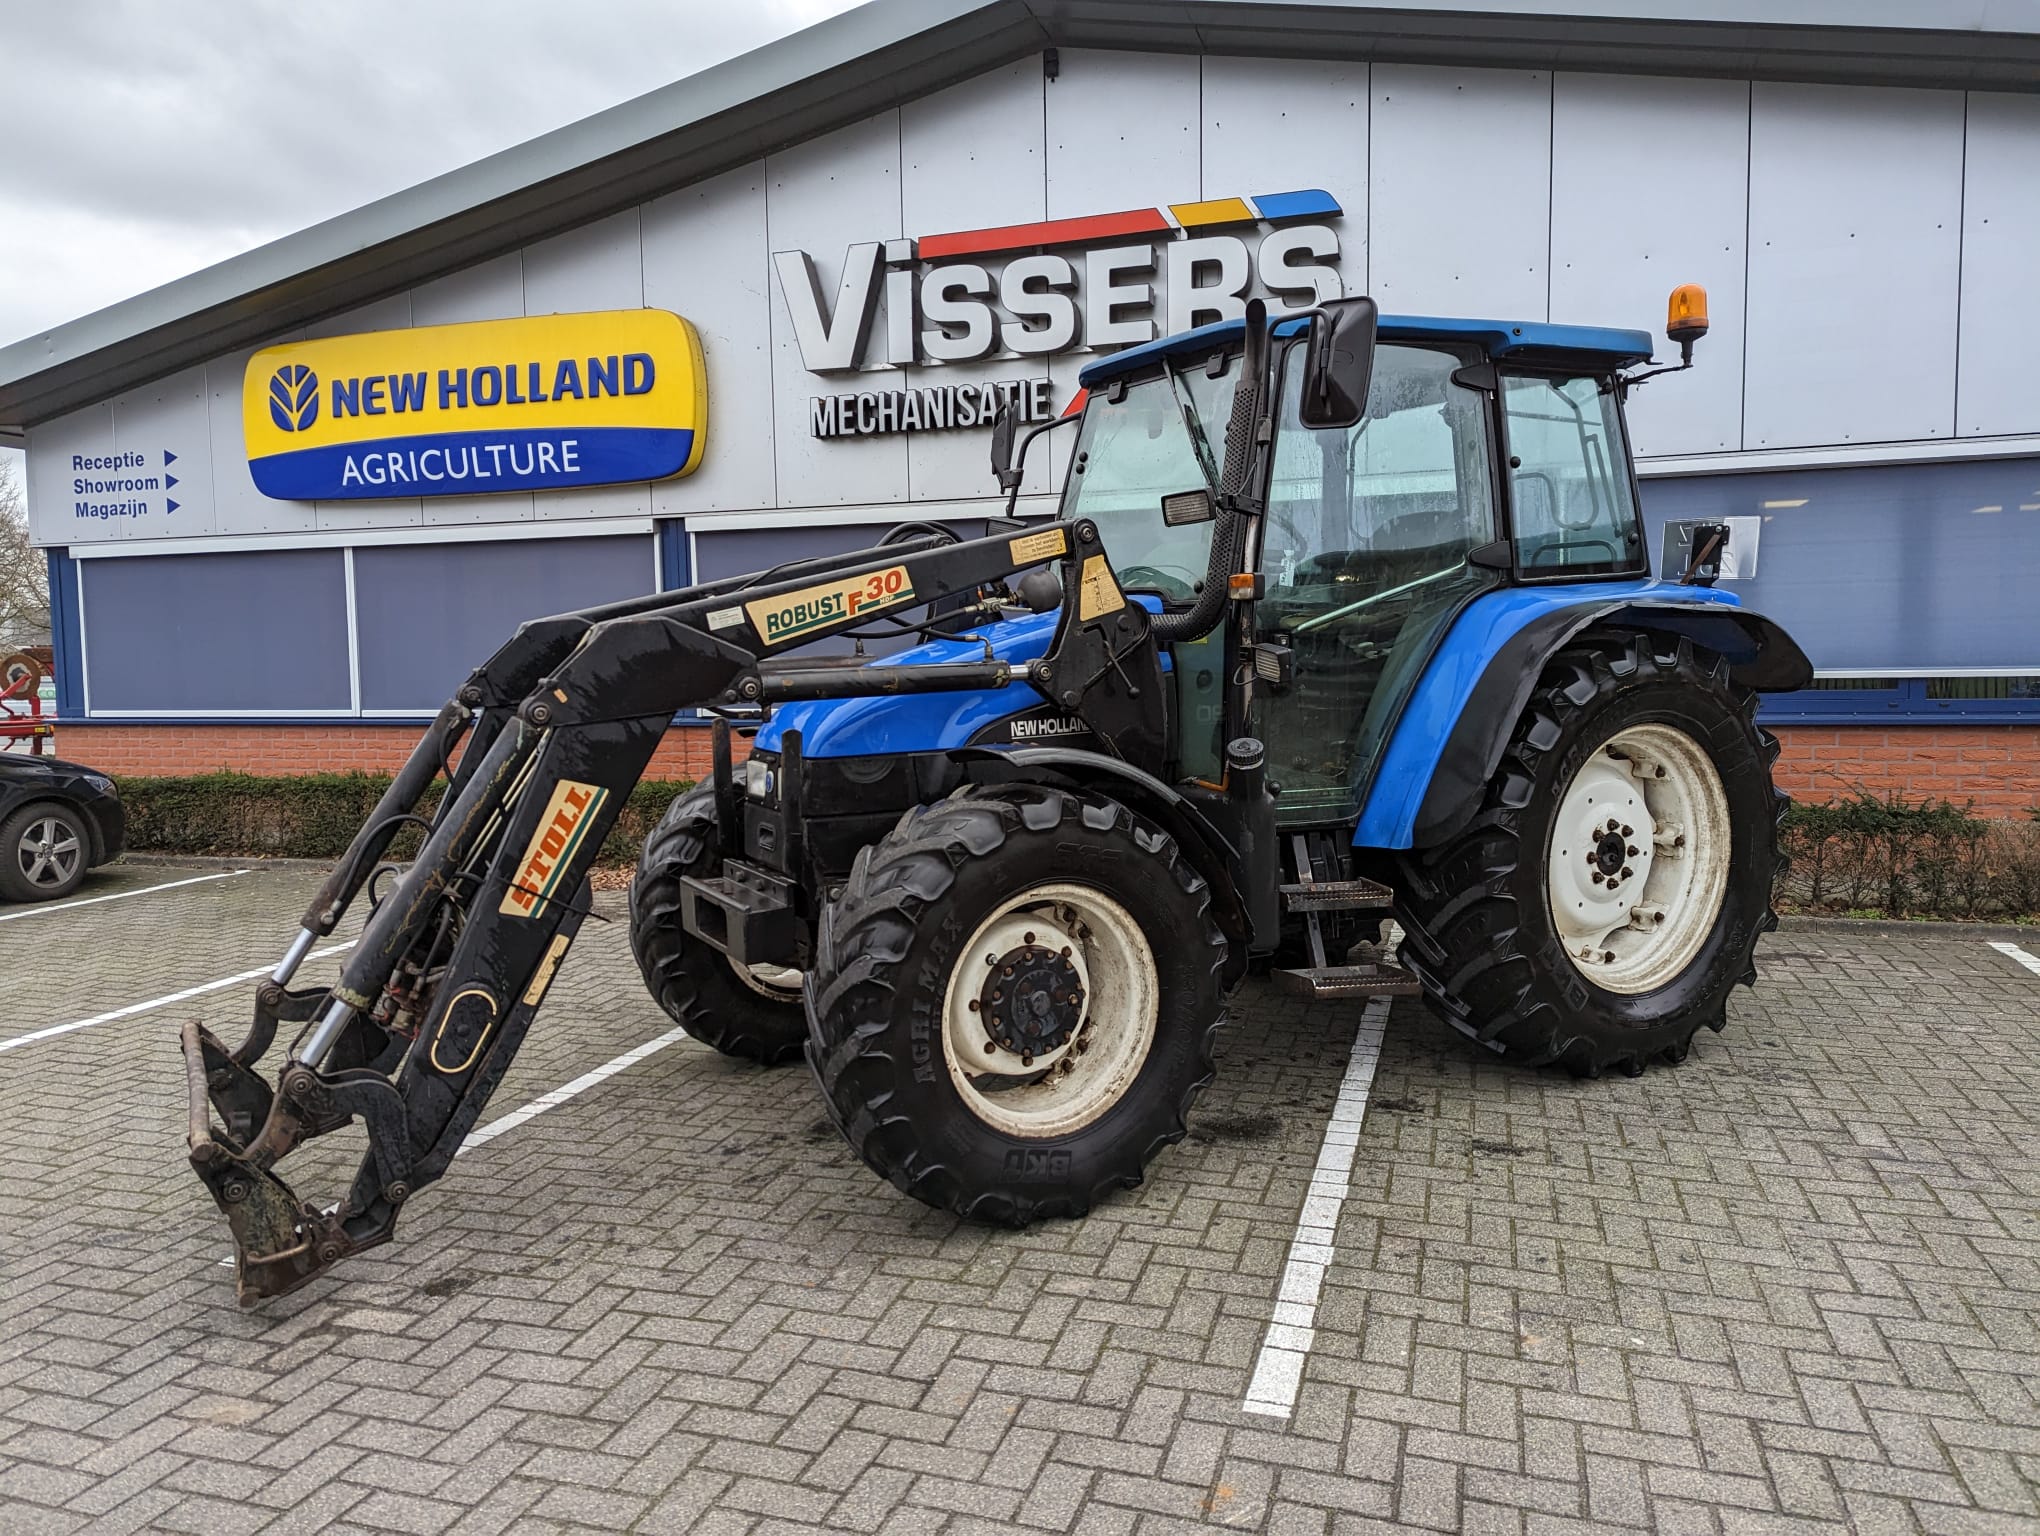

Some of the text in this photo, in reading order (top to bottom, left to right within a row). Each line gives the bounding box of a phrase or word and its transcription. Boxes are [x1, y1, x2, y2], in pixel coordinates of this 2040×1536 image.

[331, 352, 656, 418] NEW HOLLAND
[809, 377, 1050, 438] MECHANISATIE
[72, 451, 145, 472] Receptie
[342, 440, 581, 486] AGRICULTURE
[73, 477, 159, 495] Showroom
[75, 499, 148, 520] Magazijn
[766, 592, 843, 632] ROBUST
[848, 591, 863, 616] F
[866, 570, 902, 600] 30
[1010, 716, 1089, 736] NEW HOLLAN
[511, 786, 592, 910] STOLL
